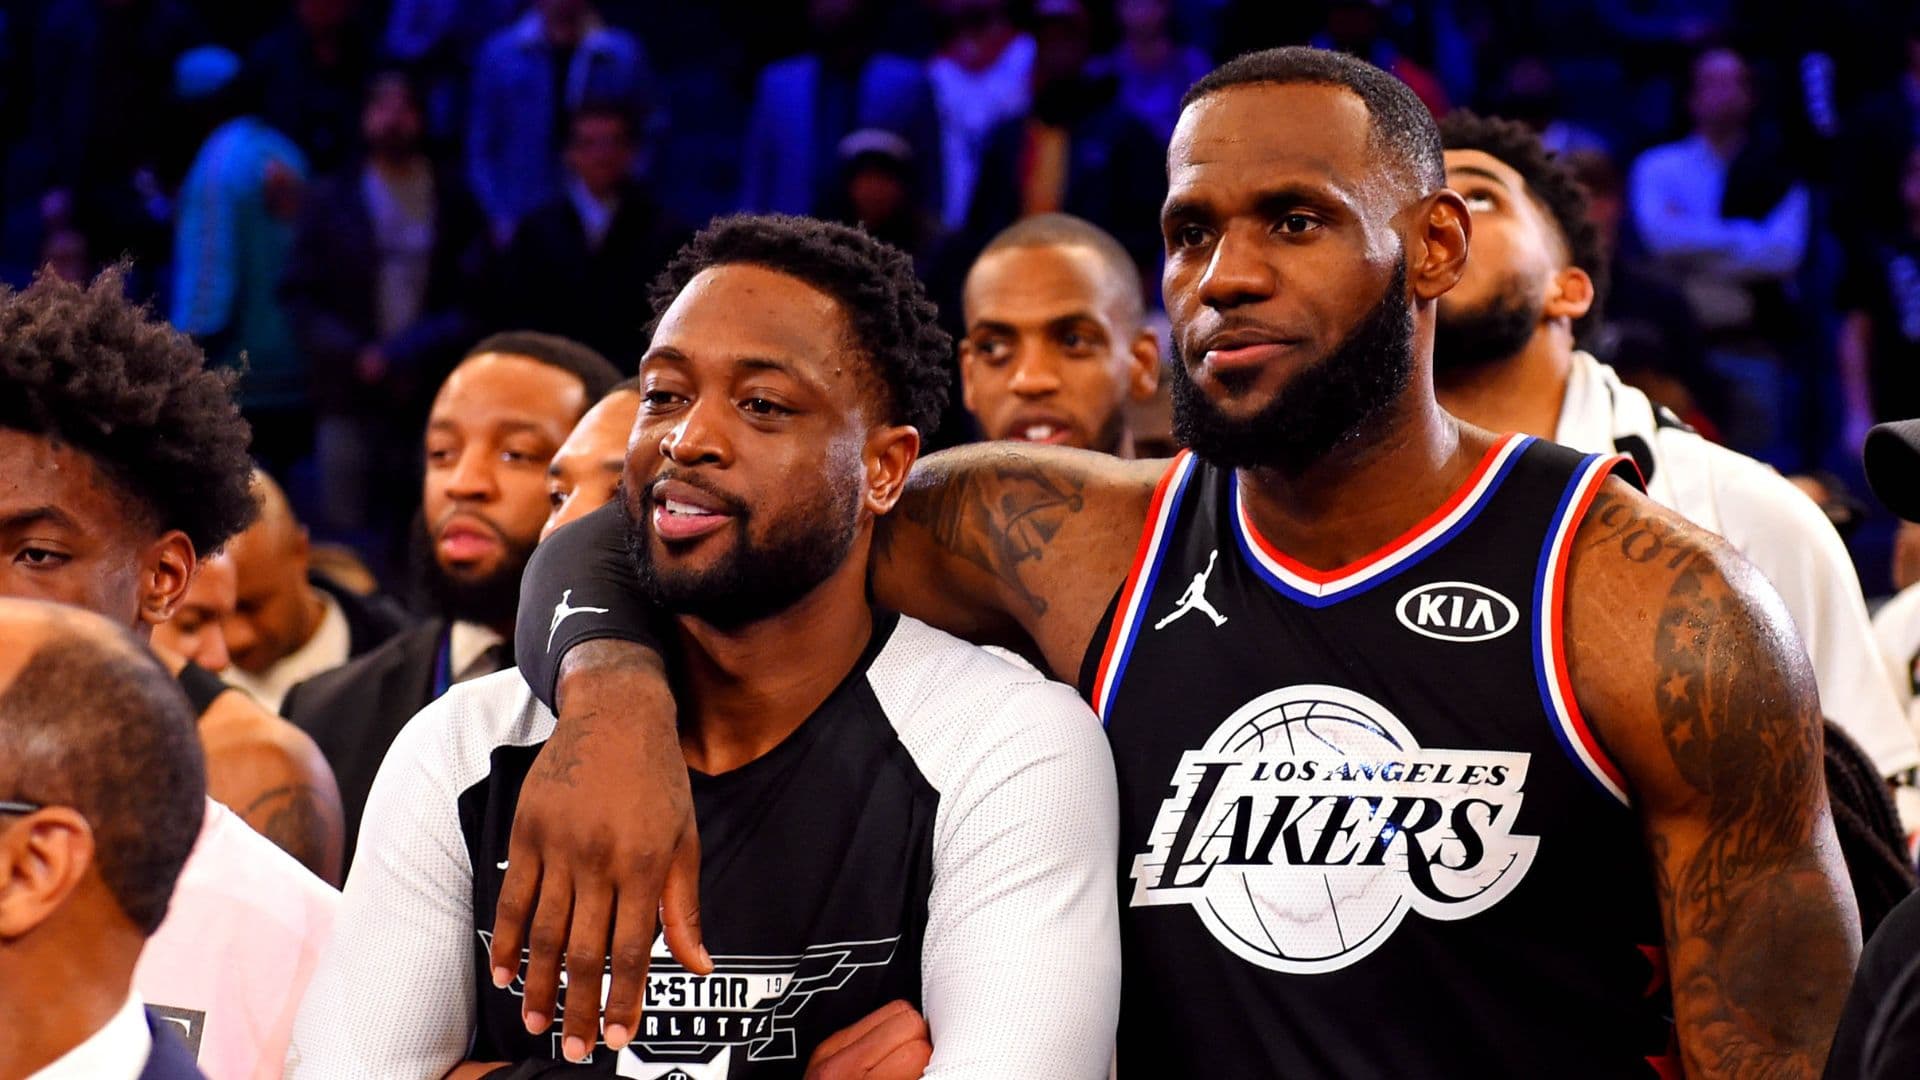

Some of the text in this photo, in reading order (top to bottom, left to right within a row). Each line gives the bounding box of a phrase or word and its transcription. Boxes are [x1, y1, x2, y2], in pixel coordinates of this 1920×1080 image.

[1417, 593, 1496, 632] KIA
[1250, 760, 1510, 787] LOS ANGELES
[1143, 762, 1518, 899] LAKERS
[600, 1016, 768, 1037] RLOTTE
